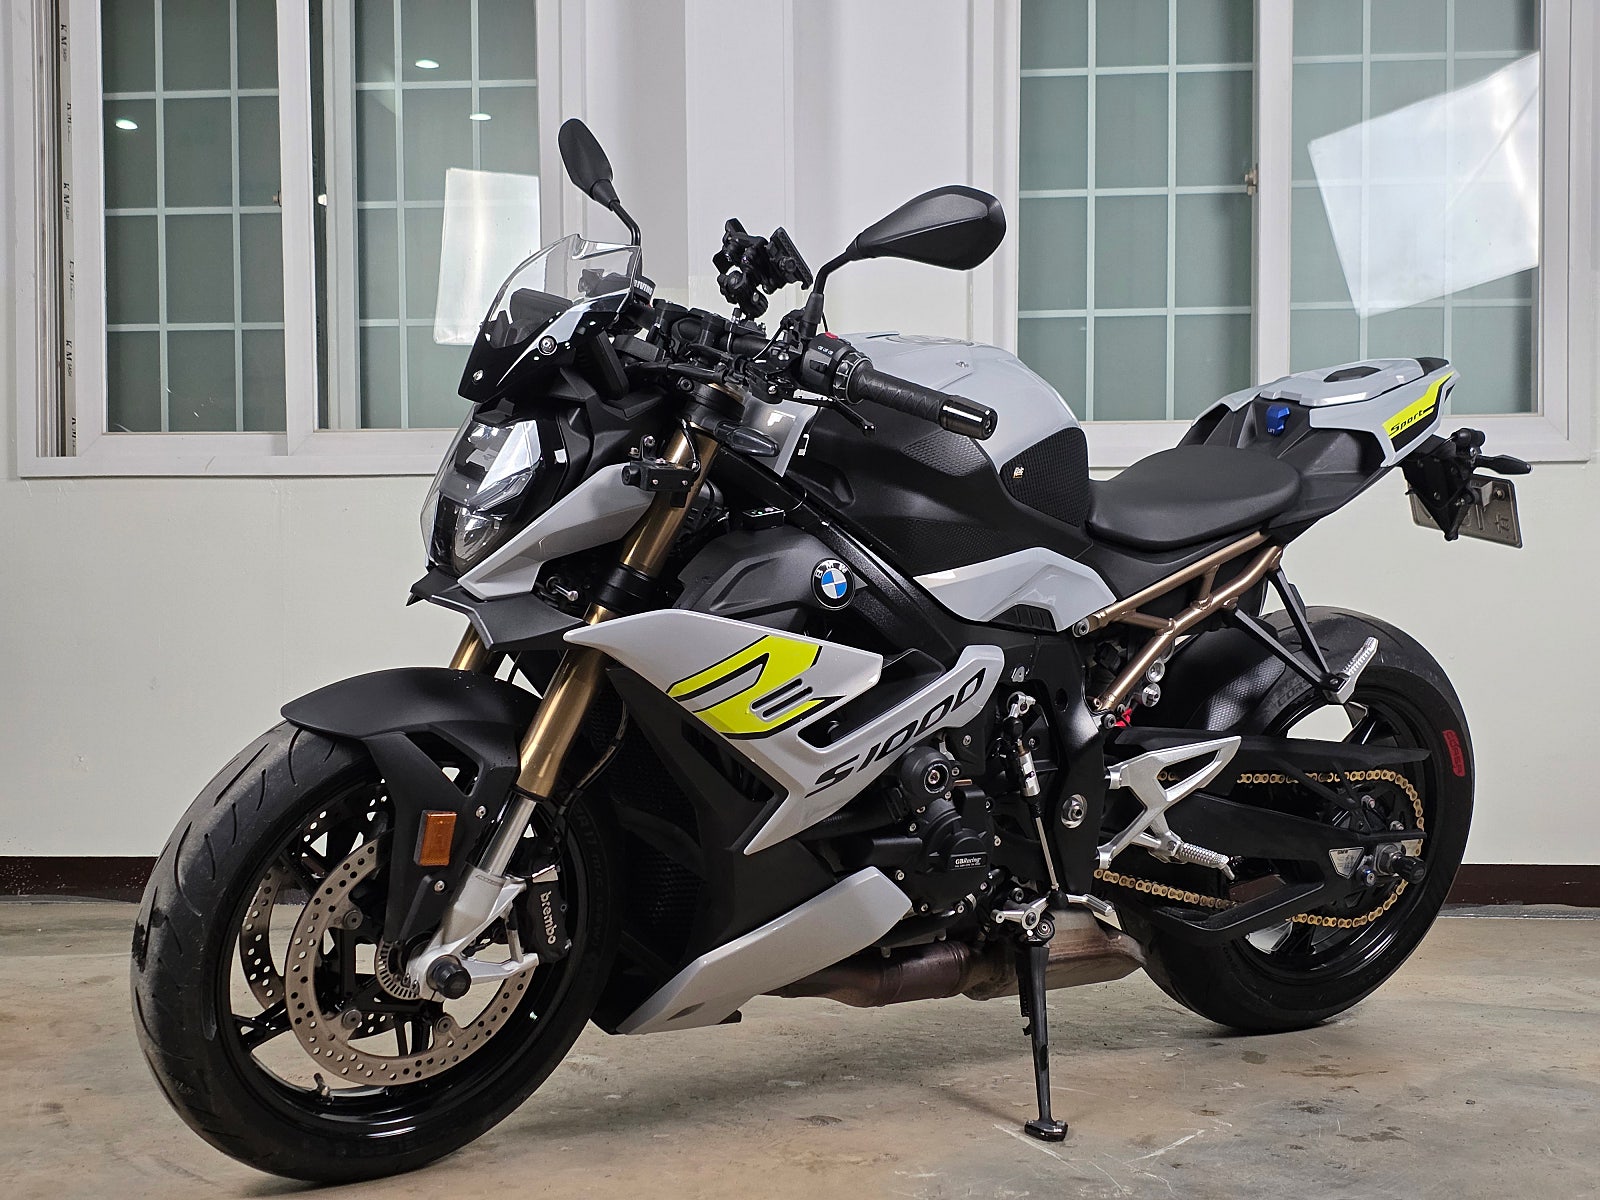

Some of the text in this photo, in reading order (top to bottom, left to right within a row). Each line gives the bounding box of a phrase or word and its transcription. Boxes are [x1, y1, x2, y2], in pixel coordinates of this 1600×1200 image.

[1390, 410, 1424, 432] Sport
[814, 560, 849, 579] BMW
[804, 667, 986, 798] S1000
[540, 890, 557, 945] brembo
